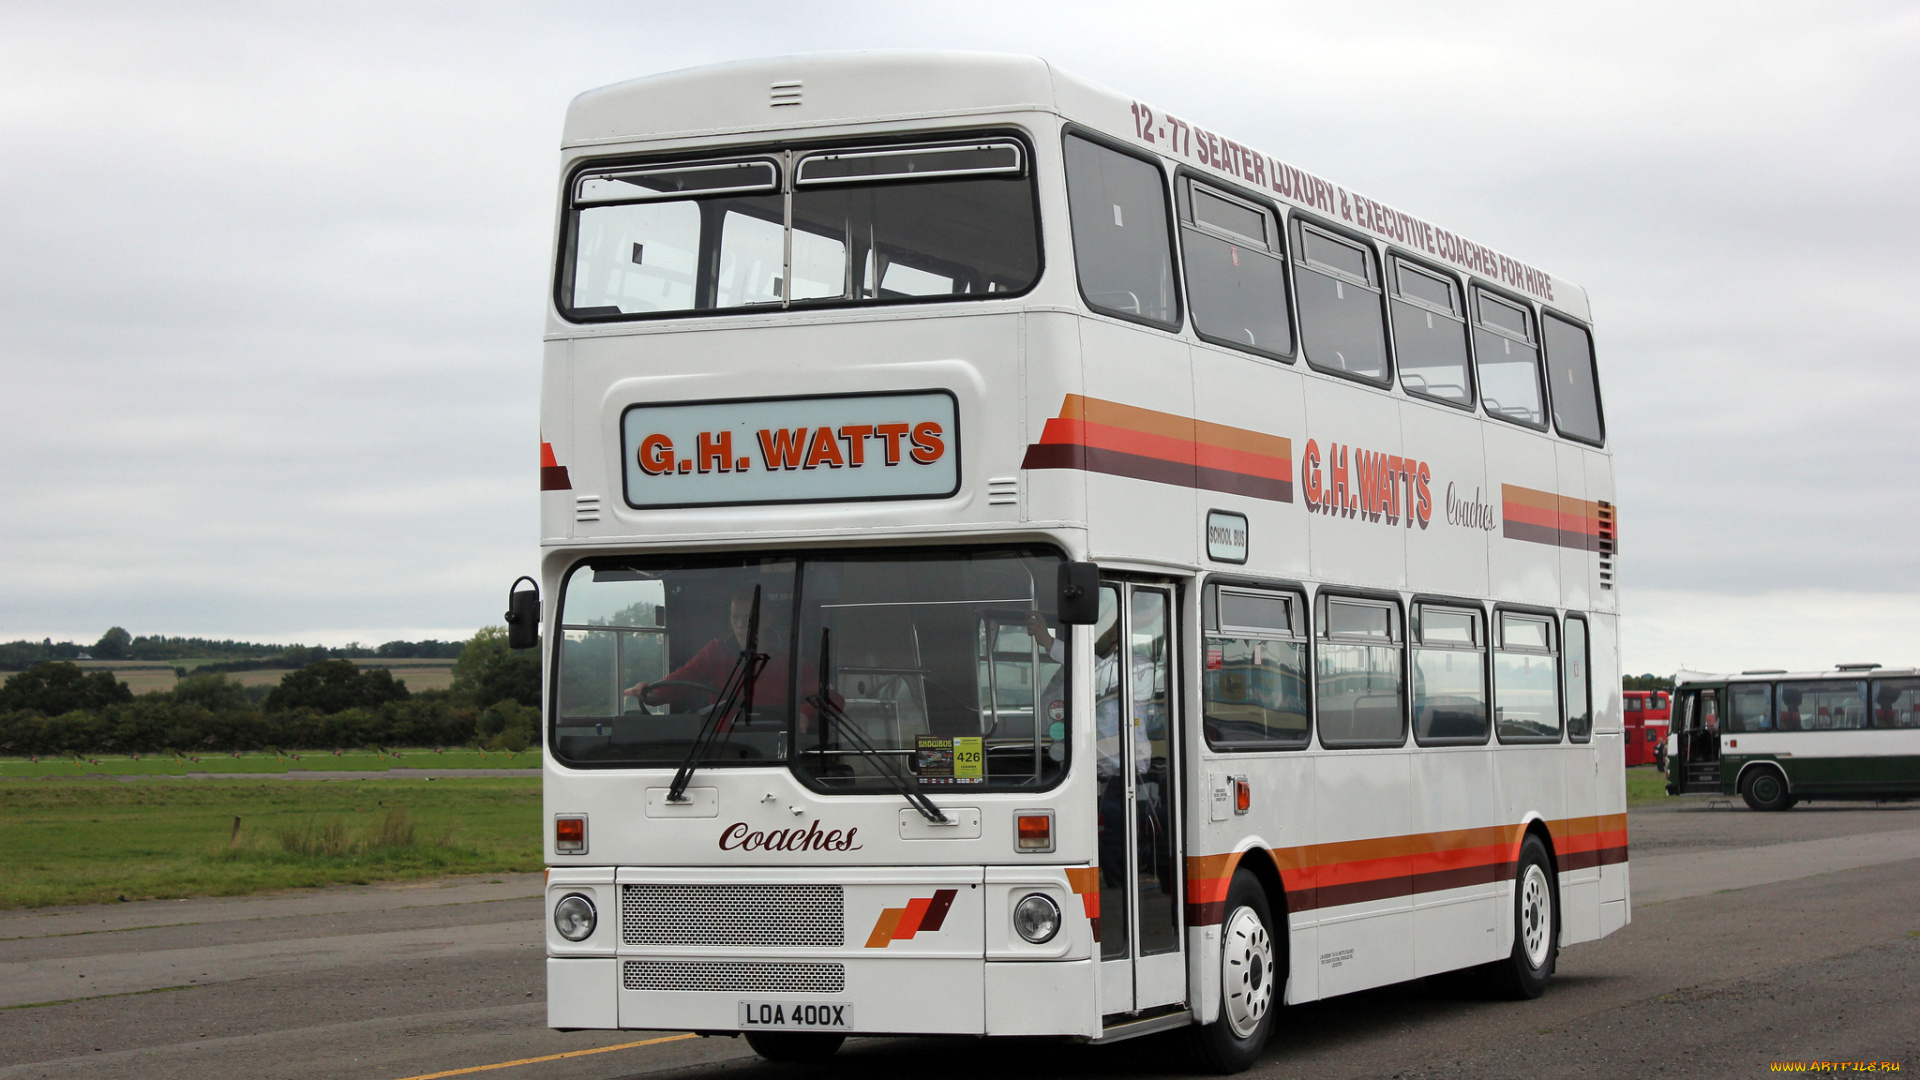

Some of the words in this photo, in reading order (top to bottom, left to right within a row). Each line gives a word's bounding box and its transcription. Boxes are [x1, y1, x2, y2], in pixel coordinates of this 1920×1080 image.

[1131, 100, 1155, 144] 12
[1165, 113, 1189, 157] 77
[1194, 126, 1266, 187] SEATER
[1268, 156, 1335, 215] LUXURY
[1338, 186, 1353, 222] &
[1352, 192, 1436, 255] EXECUTIVE
[1435, 226, 1498, 279] COACHES
[1498, 252, 1525, 290] FOR
[1523, 263, 1554, 301] HIRE
[1446, 480, 1496, 531] Coaches
[1209, 525, 1232, 546] SCHOOL
[1233, 529, 1245, 548] BUS
[956, 752, 981, 763] 426
[719, 819, 863, 852] Coaches
[746, 1003, 785, 1025] LOA
[791, 1004, 845, 1026] 400X
